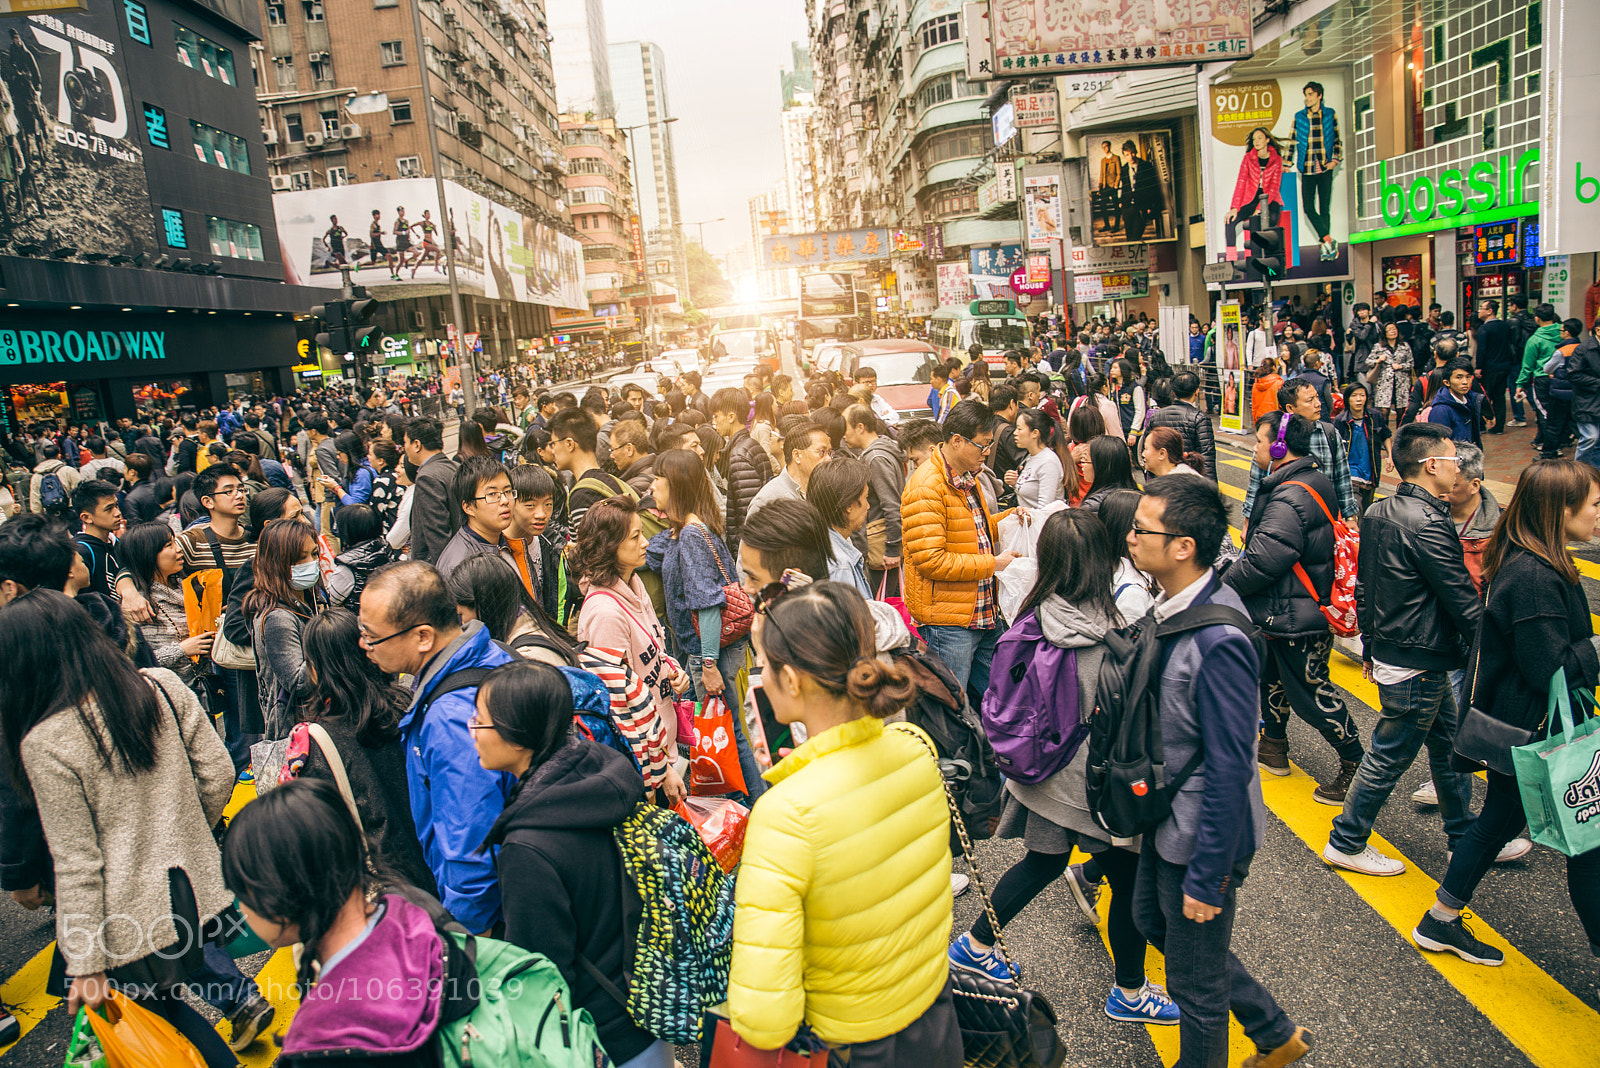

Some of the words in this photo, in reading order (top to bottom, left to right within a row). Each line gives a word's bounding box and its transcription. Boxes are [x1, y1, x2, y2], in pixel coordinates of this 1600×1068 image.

[1060, 31, 1136, 50] SHING
[1154, 24, 1241, 43] HOTEL
[29, 25, 128, 140] 7D
[1015, 96, 1039, 112] 知足
[1215, 91, 1273, 113] 90/10
[53, 125, 89, 150] EOS
[1019, 282, 1044, 290] HOUSE
[20, 330, 166, 364] BROADWAY
